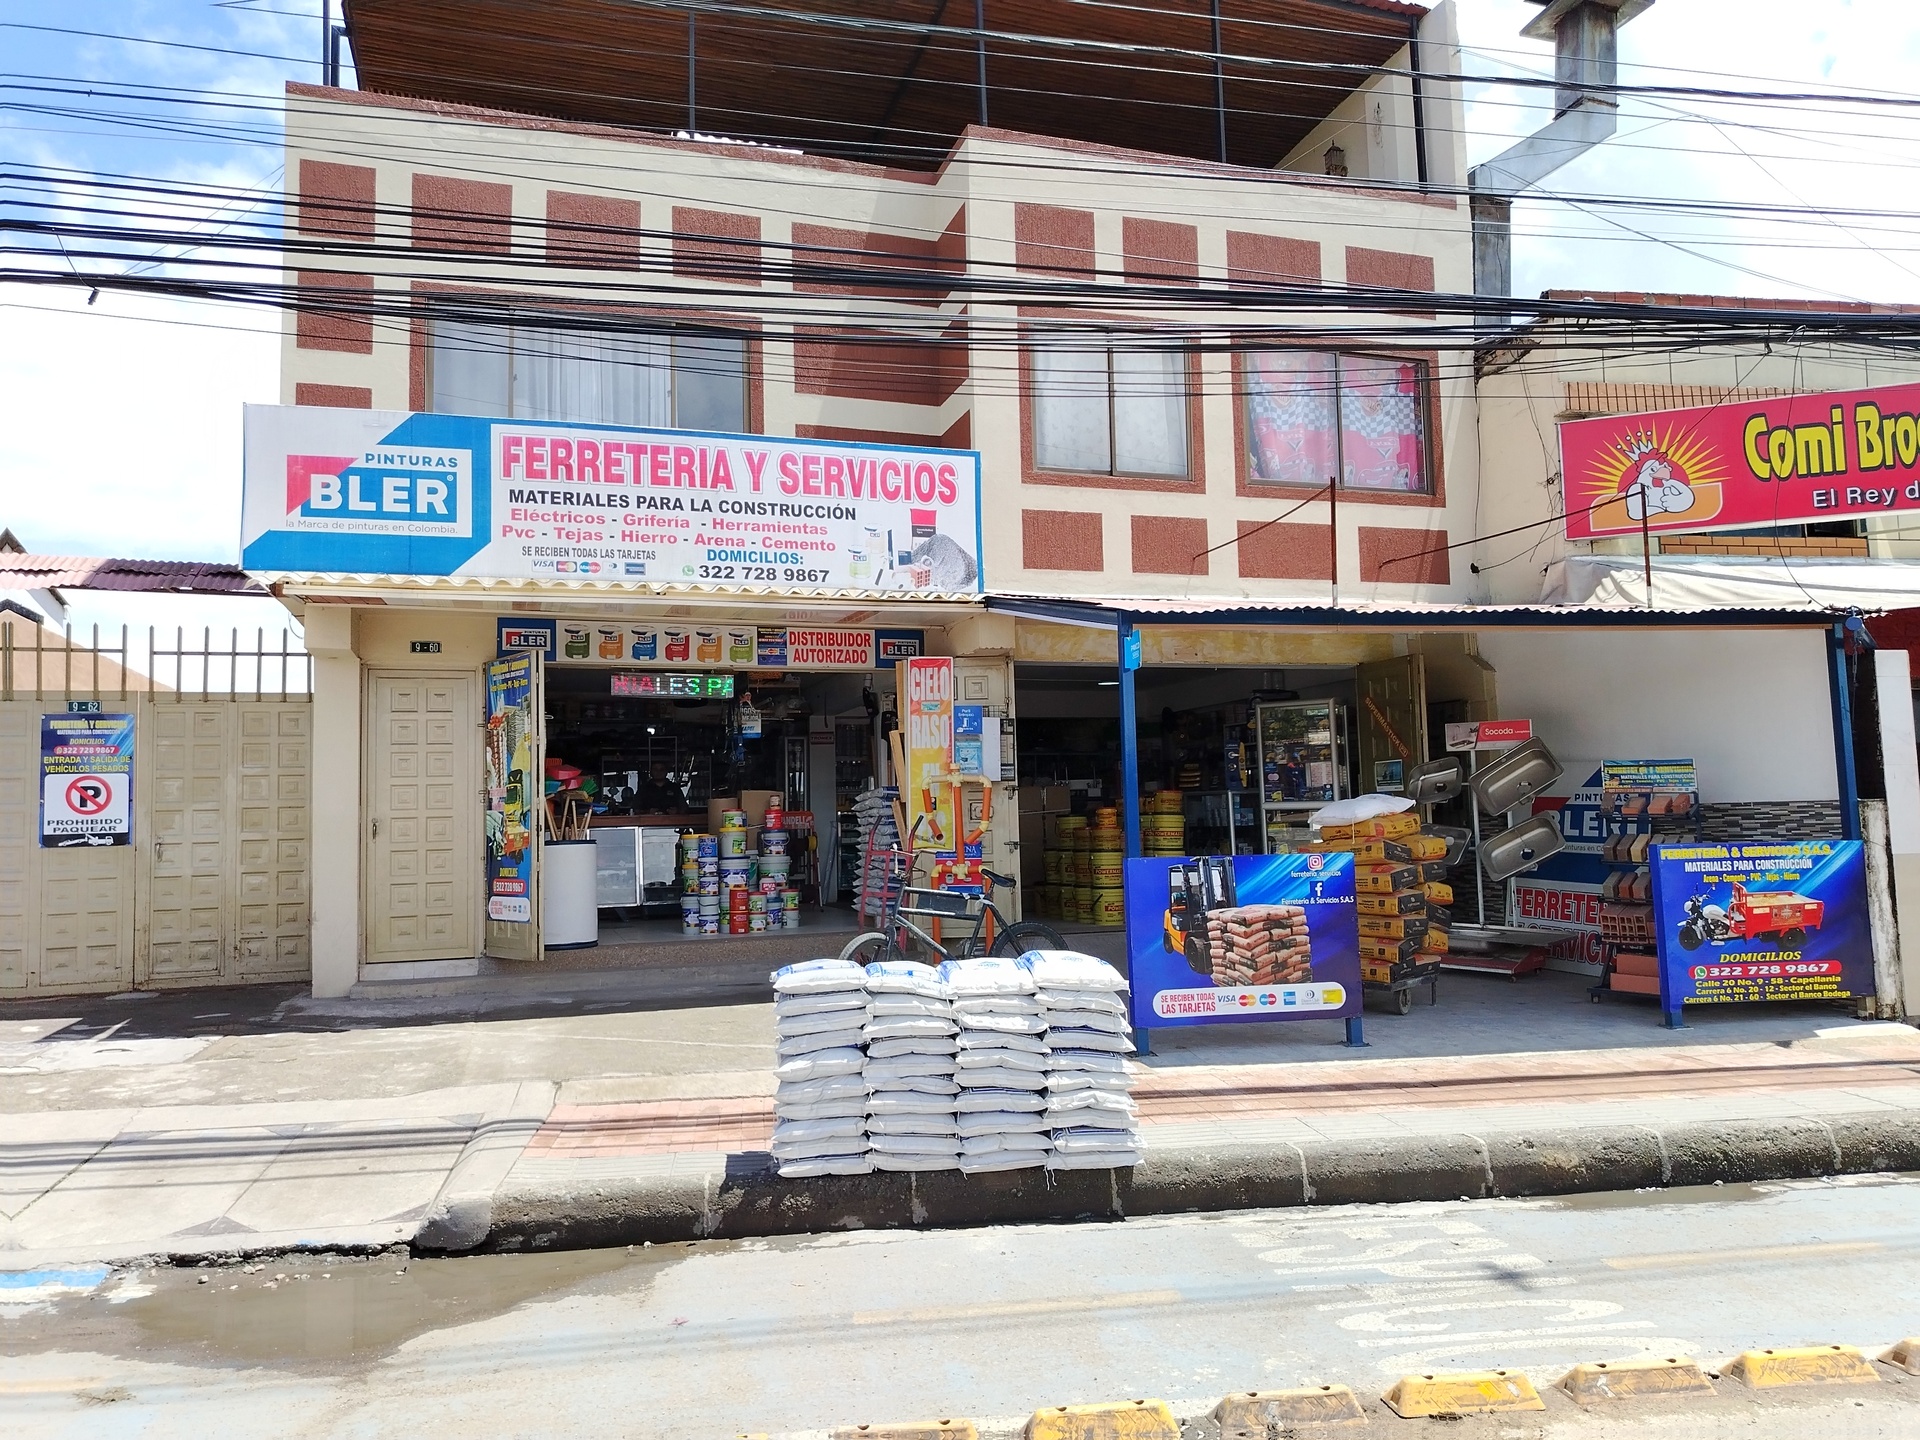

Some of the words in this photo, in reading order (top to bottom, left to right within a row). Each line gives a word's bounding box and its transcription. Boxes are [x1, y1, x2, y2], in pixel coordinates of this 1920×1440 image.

[1743, 405, 1848, 481] Comi
[1855, 402, 1920, 471] Bro
[365, 452, 458, 468] PINTURAS
[502, 435, 735, 491] FERRETERIA
[743, 450, 769, 492] Y
[779, 453, 958, 504] SERVICIOS
[310, 473, 449, 515] BLER
[1813, 488, 1837, 508] El
[1846, 486, 1896, 506] Rey
[509, 489, 630, 508] MATERIALES
[636, 495, 684, 511] PARA
[690, 499, 712, 512] LA
[718, 500, 856, 520] CONSTRUCCIÓN
[285, 519, 295, 528] la
[297, 520, 328, 530] Marca
[331, 521, 345, 530] de
[348, 523, 389, 533] pinturas
[407, 524, 458, 535] Colombia.
[510, 508, 605, 525] Eléctricos
[623, 513, 690, 529] Grifería
[712, 517, 828, 535] Herramientas
[502, 525, 535, 538] Pvc
[553, 527, 603, 543] Tejas
[621, 530, 677, 544] Hierro
[694, 533, 745, 547] Arena
[761, 536, 836, 552] Cemento
[522, 546, 532, 557] SE
[534, 546, 570, 558] RECIBEN
[572, 548, 598, 558] TODAS
[600, 549, 615, 559] LAS
[617, 550, 656, 560] TARJETAS
[707, 549, 804, 565] DOMICILIOS:
[699, 565, 735, 579] 322
[742, 567, 777, 582] 728
[784, 568, 830, 583] 9867
[511, 636, 546, 646] BLER
[789, 631, 872, 648] DISTRIBUIDOR
[415, 643, 421, 652] 9
[429, 643, 439, 652] 60
[887, 646, 916, 655] BLER
[793, 648, 868, 664] AUTORIZADO
[910, 666, 950, 701] CIELO
[73, 702, 79, 712] 9
[88, 702, 98, 711] 62
[911, 714, 950, 749] RASO
[45, 764, 90, 773] VEHÍCULOS
[47, 818, 122, 826] PROHIBIDO
[53, 825, 117, 833] PAQUEAR
[1660, 845, 1729, 859] FERRETERÍA
[1731, 847, 1741, 858] &
[1743, 845, 1799, 857] SERVICIOS
[1685, 860, 1732, 872] MATERIALES
[1734, 859, 1754, 871] PARA
[1756, 857, 1812, 870] CONSTRUCCIÓN
[1750, 872, 1761, 881] PVC
[1310, 896, 1315, 904] &
[1720, 951, 1801, 963] DOMICILIOS
[1709, 967, 1743, 977] 322
[1748, 965, 1781, 975] 728
[1785, 963, 1829, 973] 9867
[1696, 979, 1720, 987] Calle
[1790, 976, 1841, 985] Capellania
[1170, 994, 1194, 1002] RECIBEN
[1196, 993, 1215, 1001] TODAS
[1799, 991, 1821, 999] Banco
[1823, 990, 1850, 999] Bodega
[1161, 1003, 1175, 1014] LAS
[1177, 1001, 1216, 1013] TARJETAS
